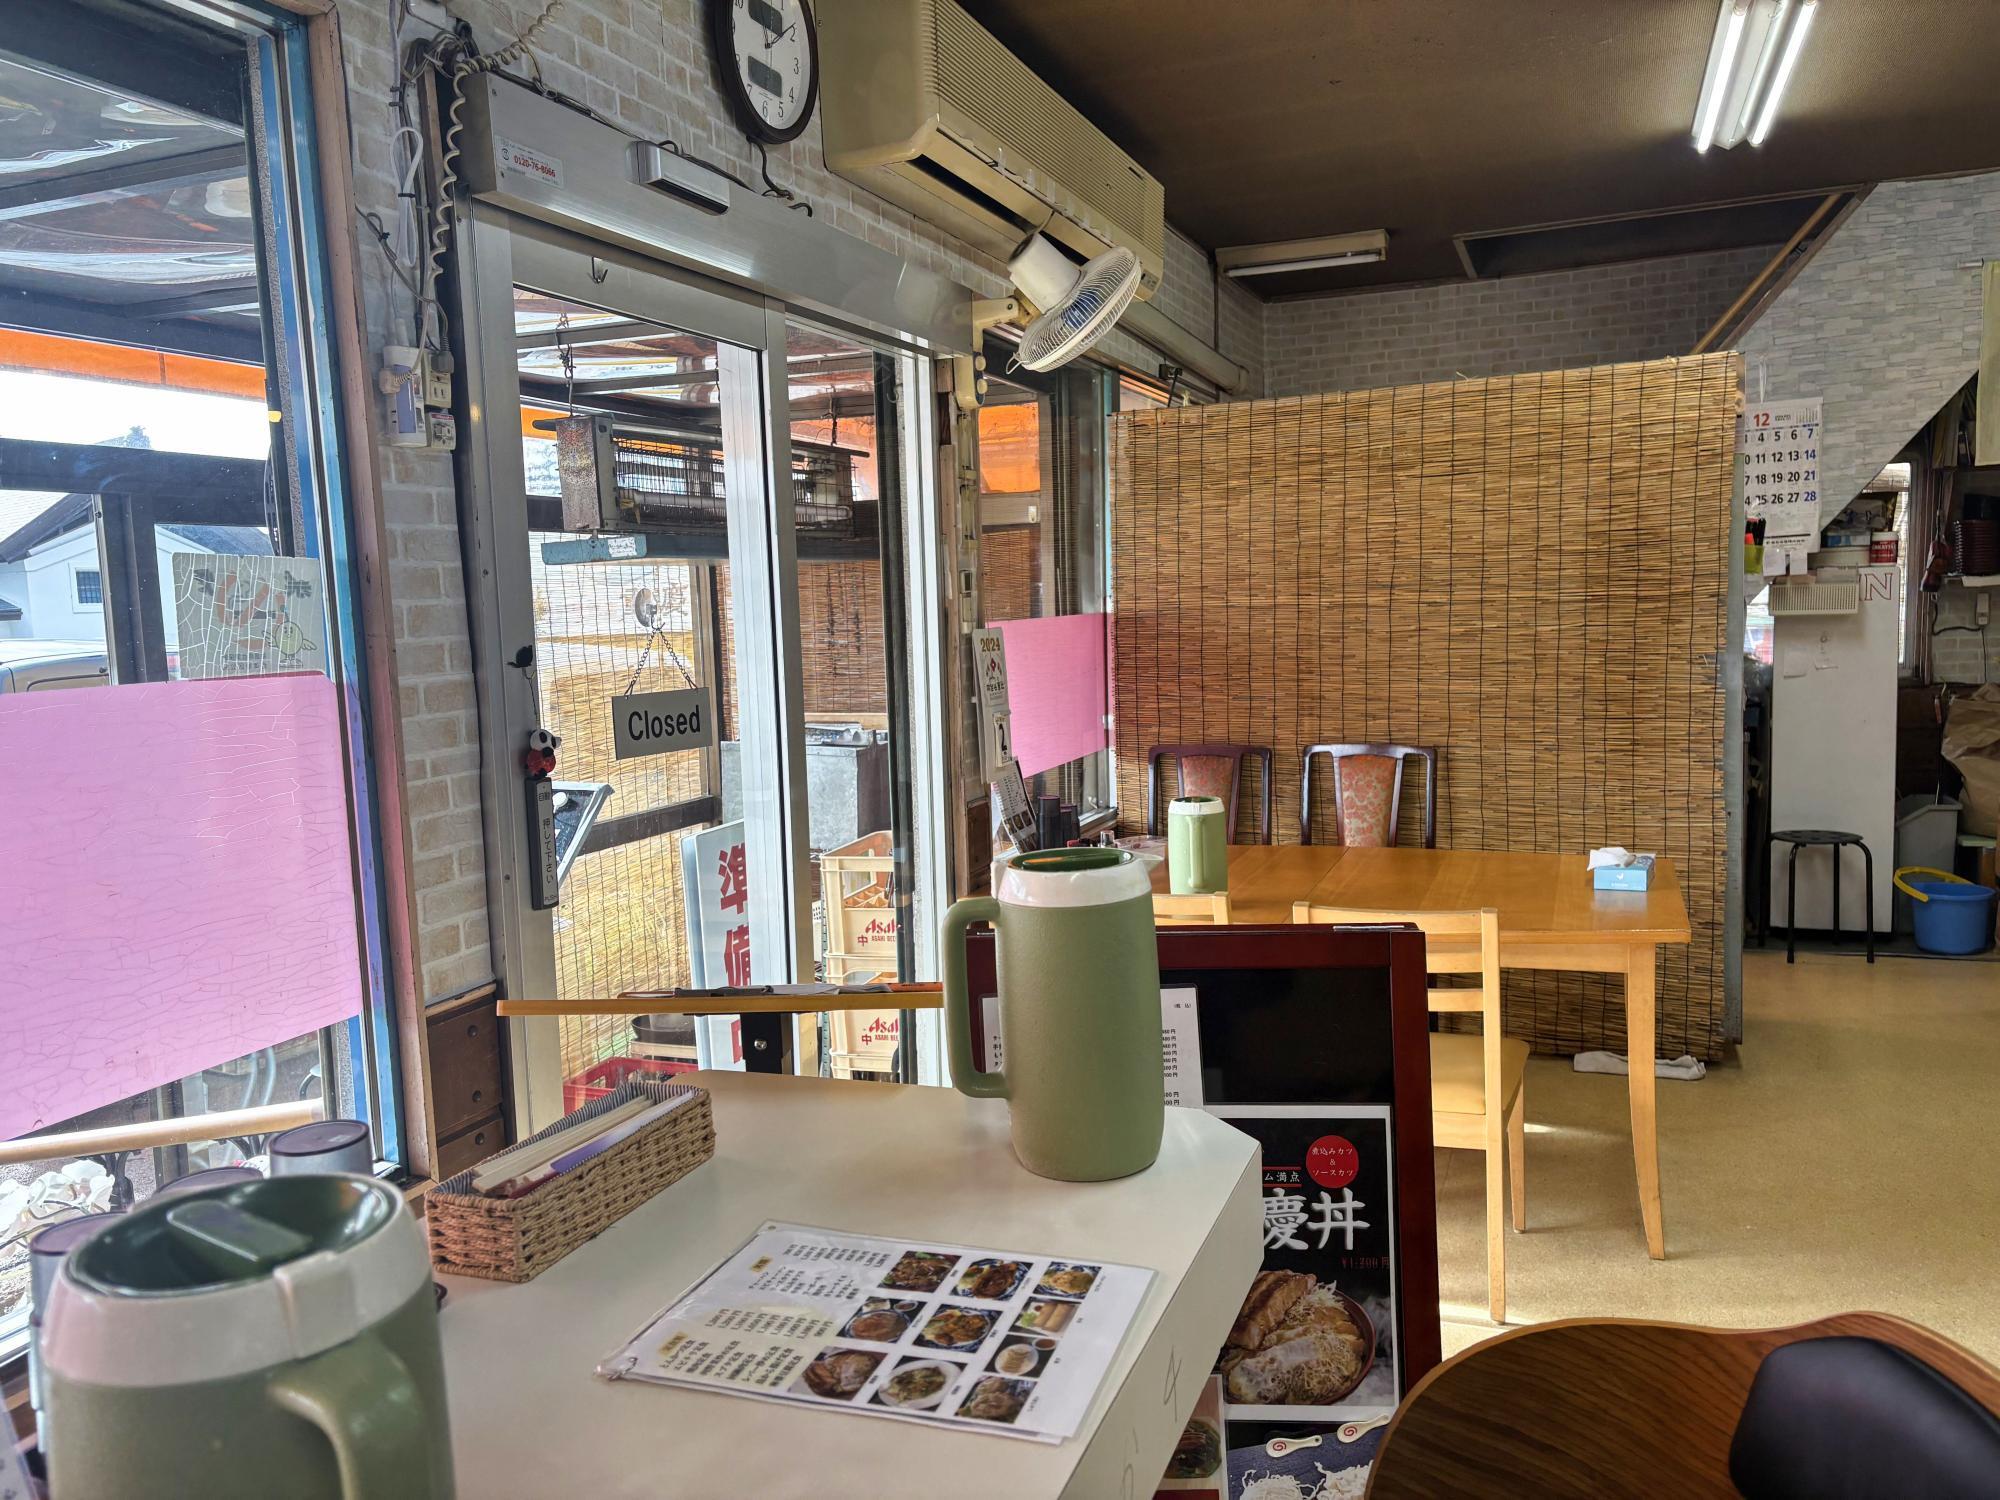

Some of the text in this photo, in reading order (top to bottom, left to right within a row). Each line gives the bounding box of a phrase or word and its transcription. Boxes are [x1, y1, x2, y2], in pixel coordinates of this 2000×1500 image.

[793, 57, 800, 75] 3
[788, 86, 795, 103] 4
[762, 100, 769, 118] 6
[778, 101, 784, 118] 5
[1753, 413, 1770, 427] 12
[1758, 428, 1814, 443] 4 5 6 7
[1755, 453, 1766, 464] 11
[1771, 451, 1783, 463] 12
[1788, 450, 1800, 461] 13
[1804, 449, 1816, 460] 14
[1755, 474, 1767, 485] 18
[1771, 472, 1783, 483] 19
[1787, 471, 1800, 482] 20
[1804, 470, 1816, 481] 21
[1771, 493, 1783, 504] 26
[1787, 492, 1800, 503] 27
[1803, 490, 1817, 502] 28
[981, 638, 1001, 652] 2024
[628, 704, 700, 740] Closed
[542, 818, 554, 884] 押して下さい
[857, 934, 868, 947] 中
[861, 1034, 872, 1046] 中
[1311, 1146, 1353, 1156] 煮込みカツ
[1312, 1168, 1354, 1177] ソースカツ
